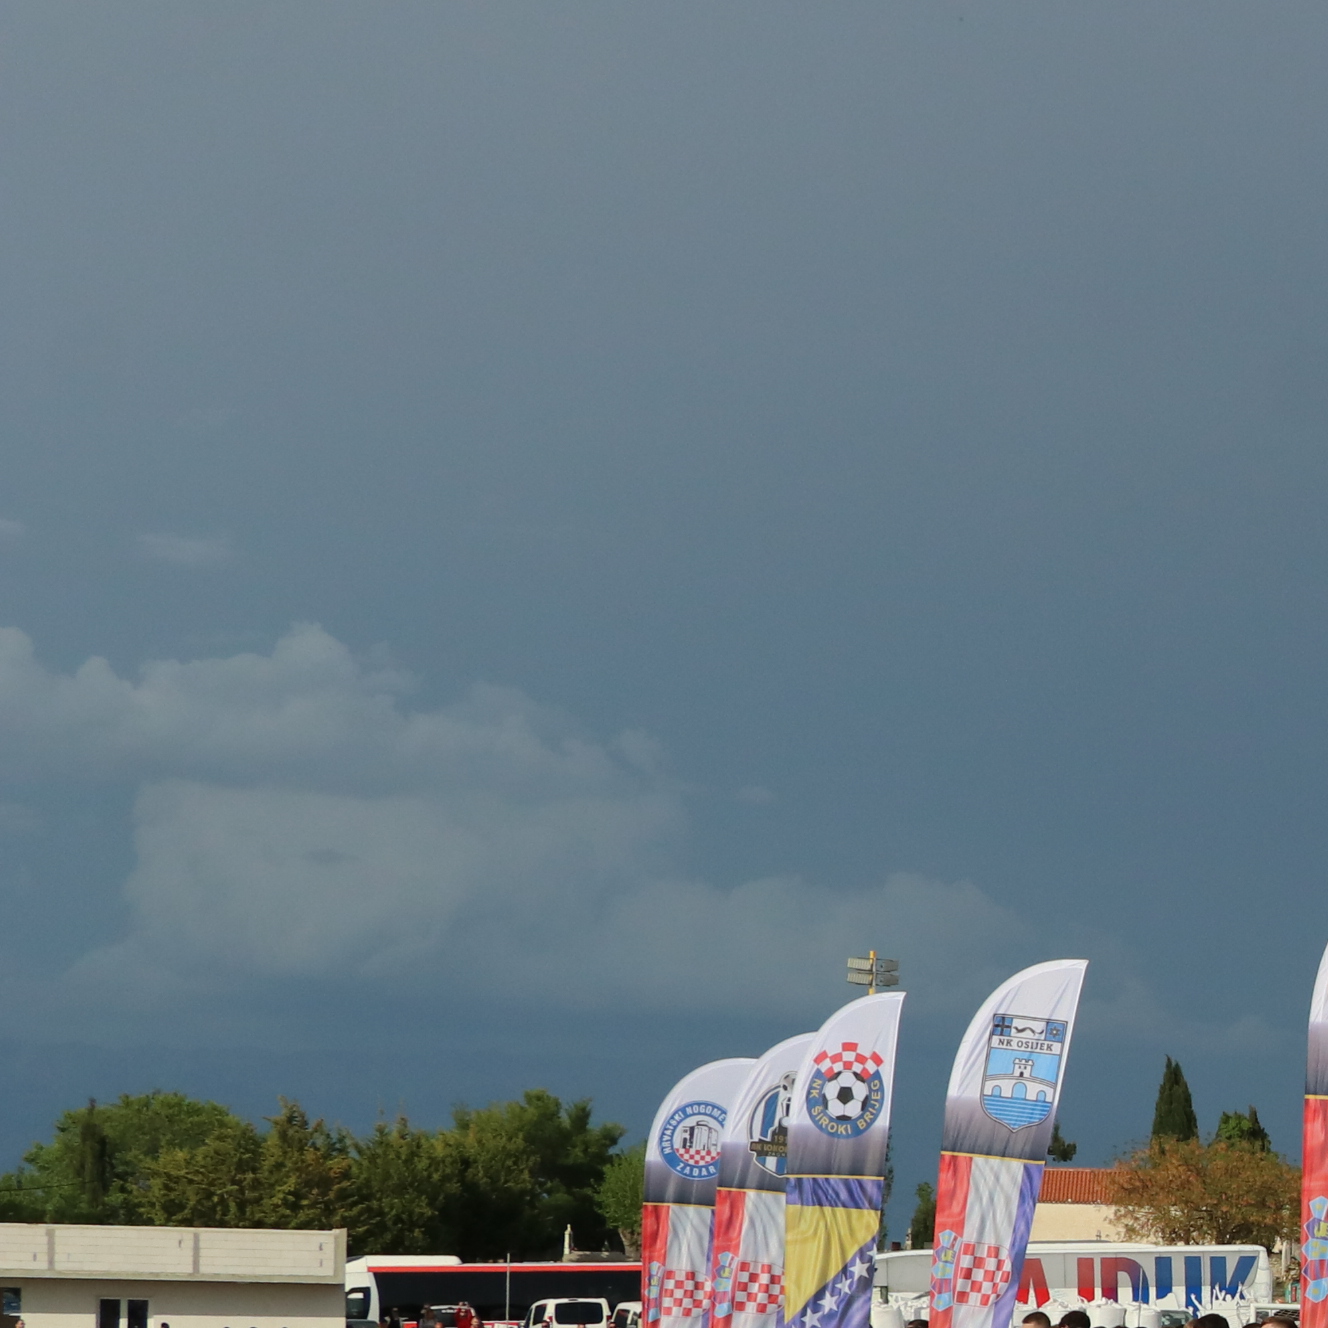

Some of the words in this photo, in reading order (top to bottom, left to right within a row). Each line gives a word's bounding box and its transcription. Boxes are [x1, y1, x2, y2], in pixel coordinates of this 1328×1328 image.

[997, 1038, 1013, 1047] NK
[1016, 1040, 1054, 1052] OSIJEK
[809, 1078, 823, 1098] NK
[856, 1079, 881, 1130] BRIJEG
[661, 1111, 685, 1155] HRVATSKI
[685, 1104, 727, 1122] NOGOME
[811, 1105, 852, 1135] ŠIROKI
[676, 1162, 717, 1177] ZADAR
